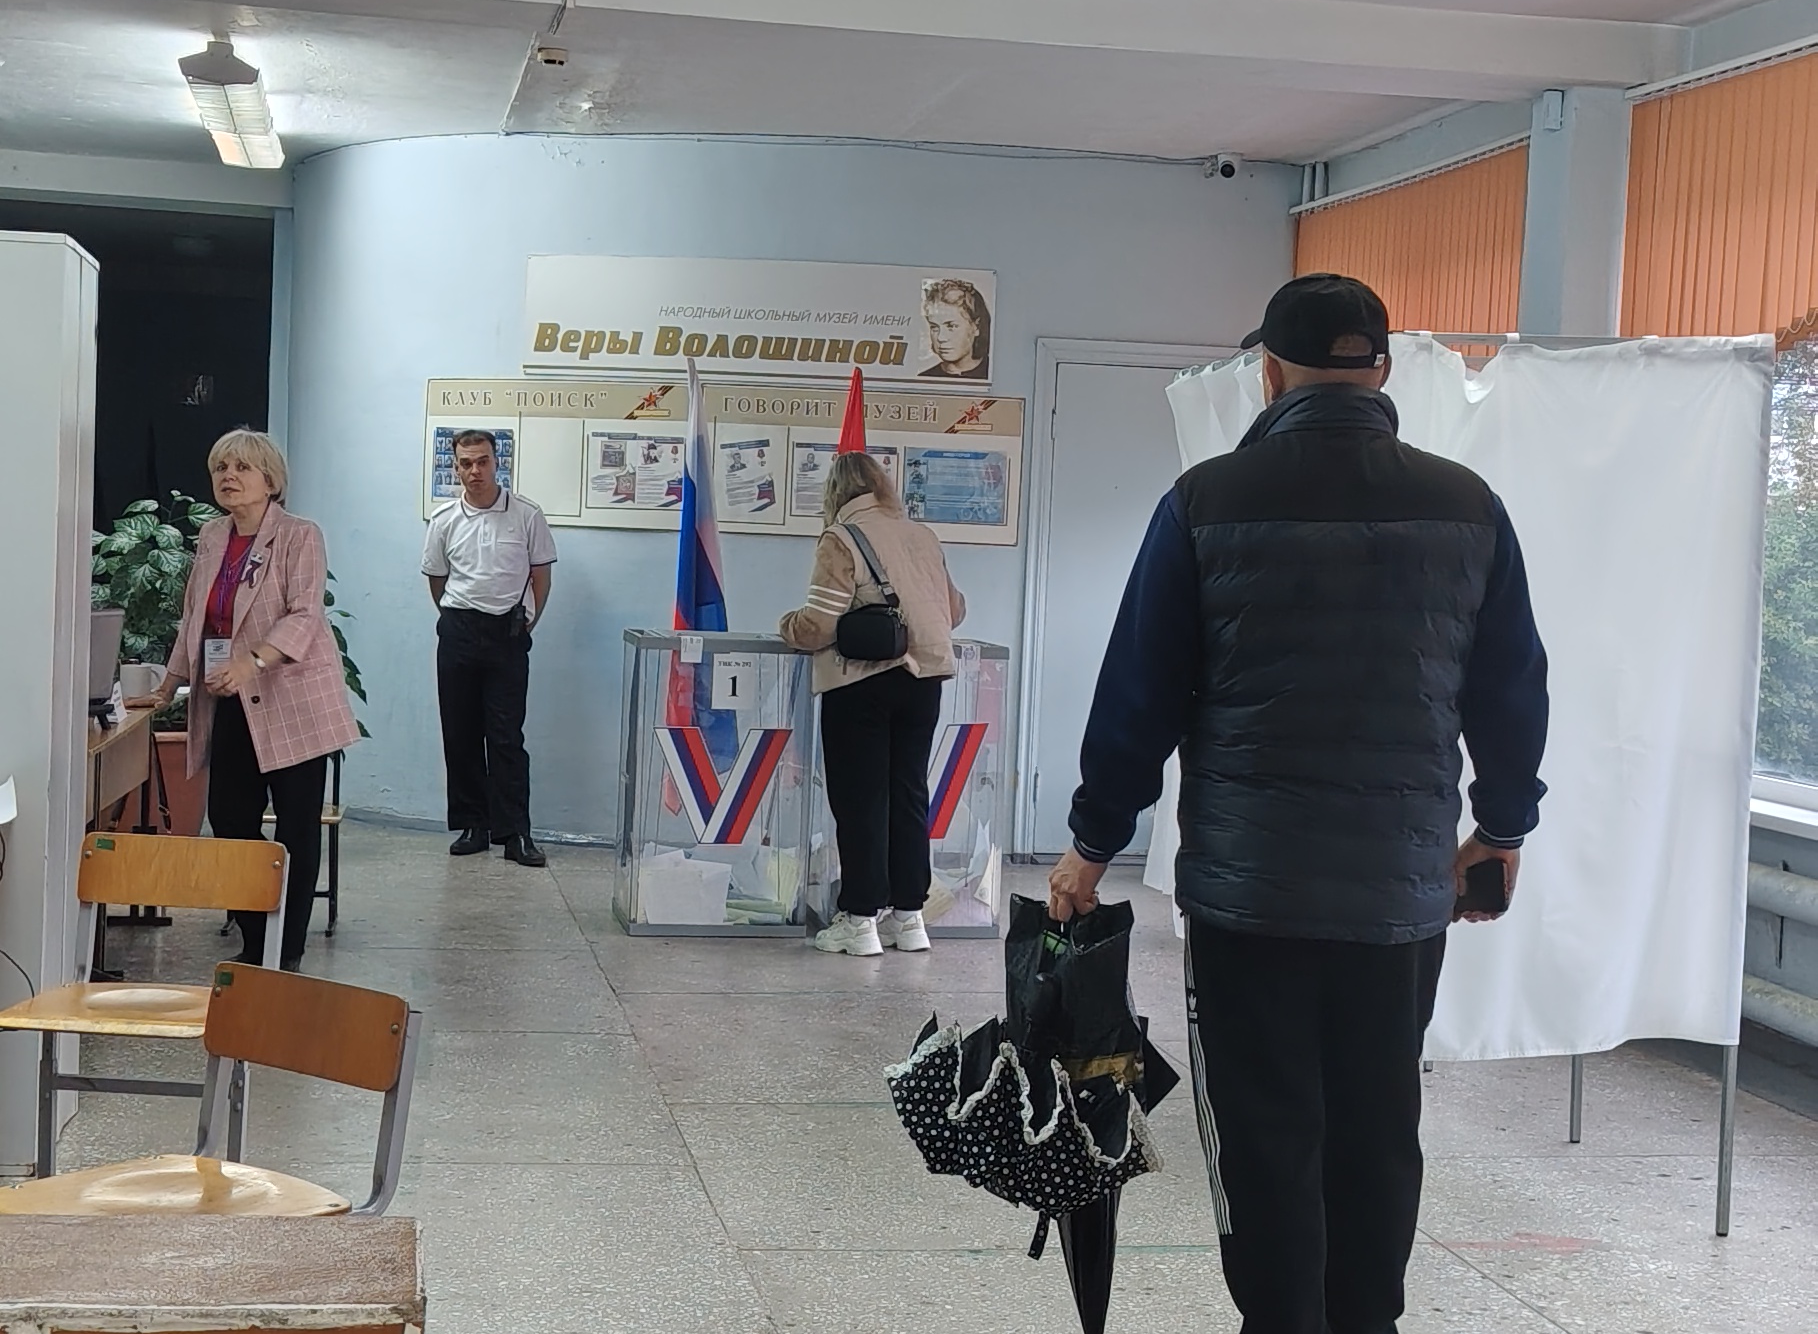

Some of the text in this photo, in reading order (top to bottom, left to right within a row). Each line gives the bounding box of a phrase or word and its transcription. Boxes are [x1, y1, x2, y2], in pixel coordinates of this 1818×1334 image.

[659, 305, 911, 326] НАРОДНЫЙ ШКОЛЬНЫЙ МУЗЕЙ ИМЕНИ
[533, 322, 909, 366] Веры Волошиной
[442, 391, 493, 406] КЛУБ
[724, 397, 837, 416] ГОВОРИТ
[728, 675, 739, 697] 1
